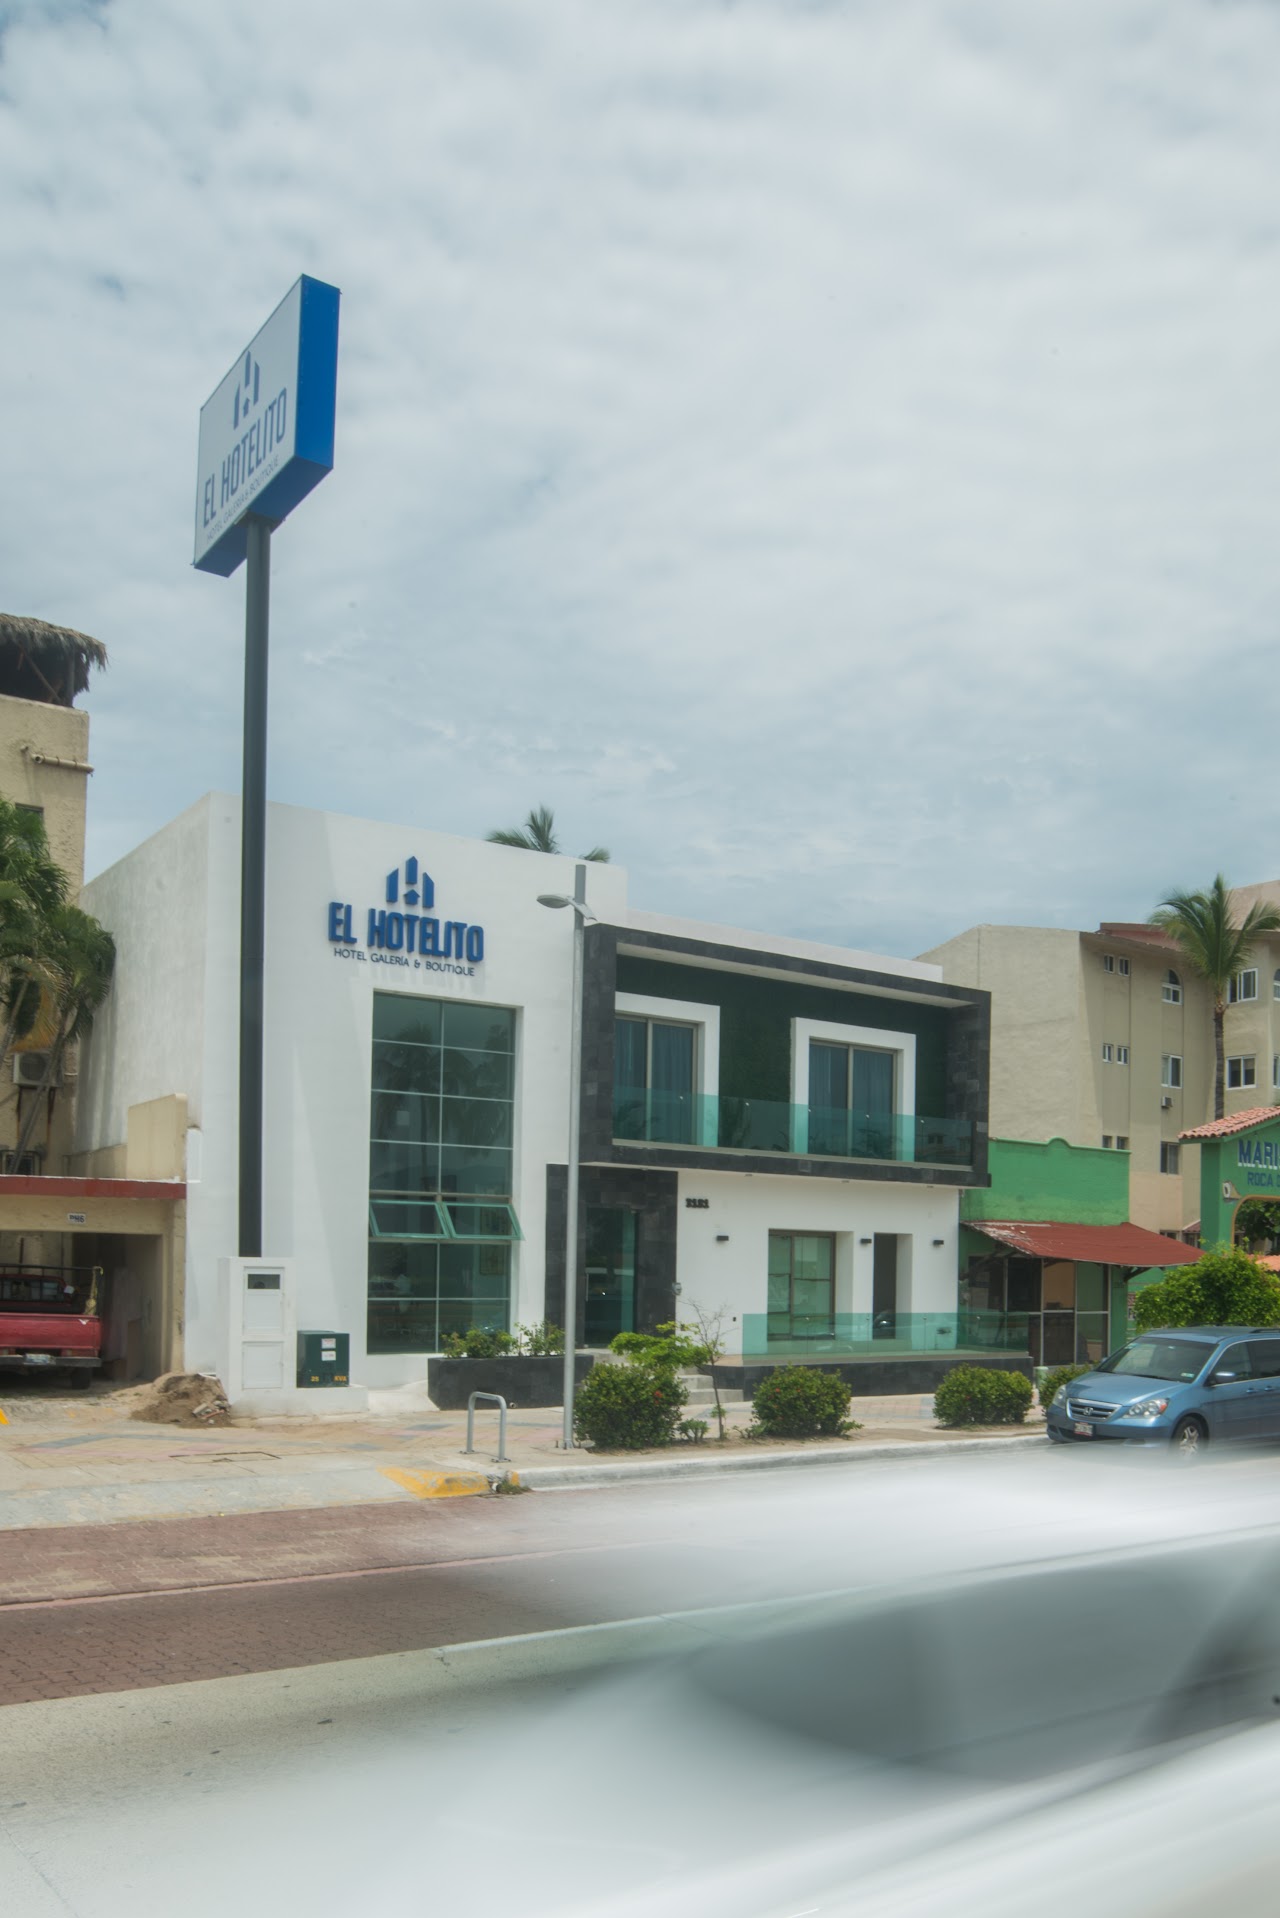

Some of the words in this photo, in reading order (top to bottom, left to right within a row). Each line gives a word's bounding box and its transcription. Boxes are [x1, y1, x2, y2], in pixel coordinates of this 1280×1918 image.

[203, 473, 217, 528] EL
[220, 386, 287, 509] HOTELITO
[328, 901, 357, 944] EL
[367, 908, 485, 963] HOTELITO
[334, 948, 367, 961] HOTEL
[414, 959, 421, 969] &
[425, 961, 475, 976] BOUTIQUE
[1238, 1139, 1280, 1170] MARI
[1247, 1171, 1274, 1188] ROCA
